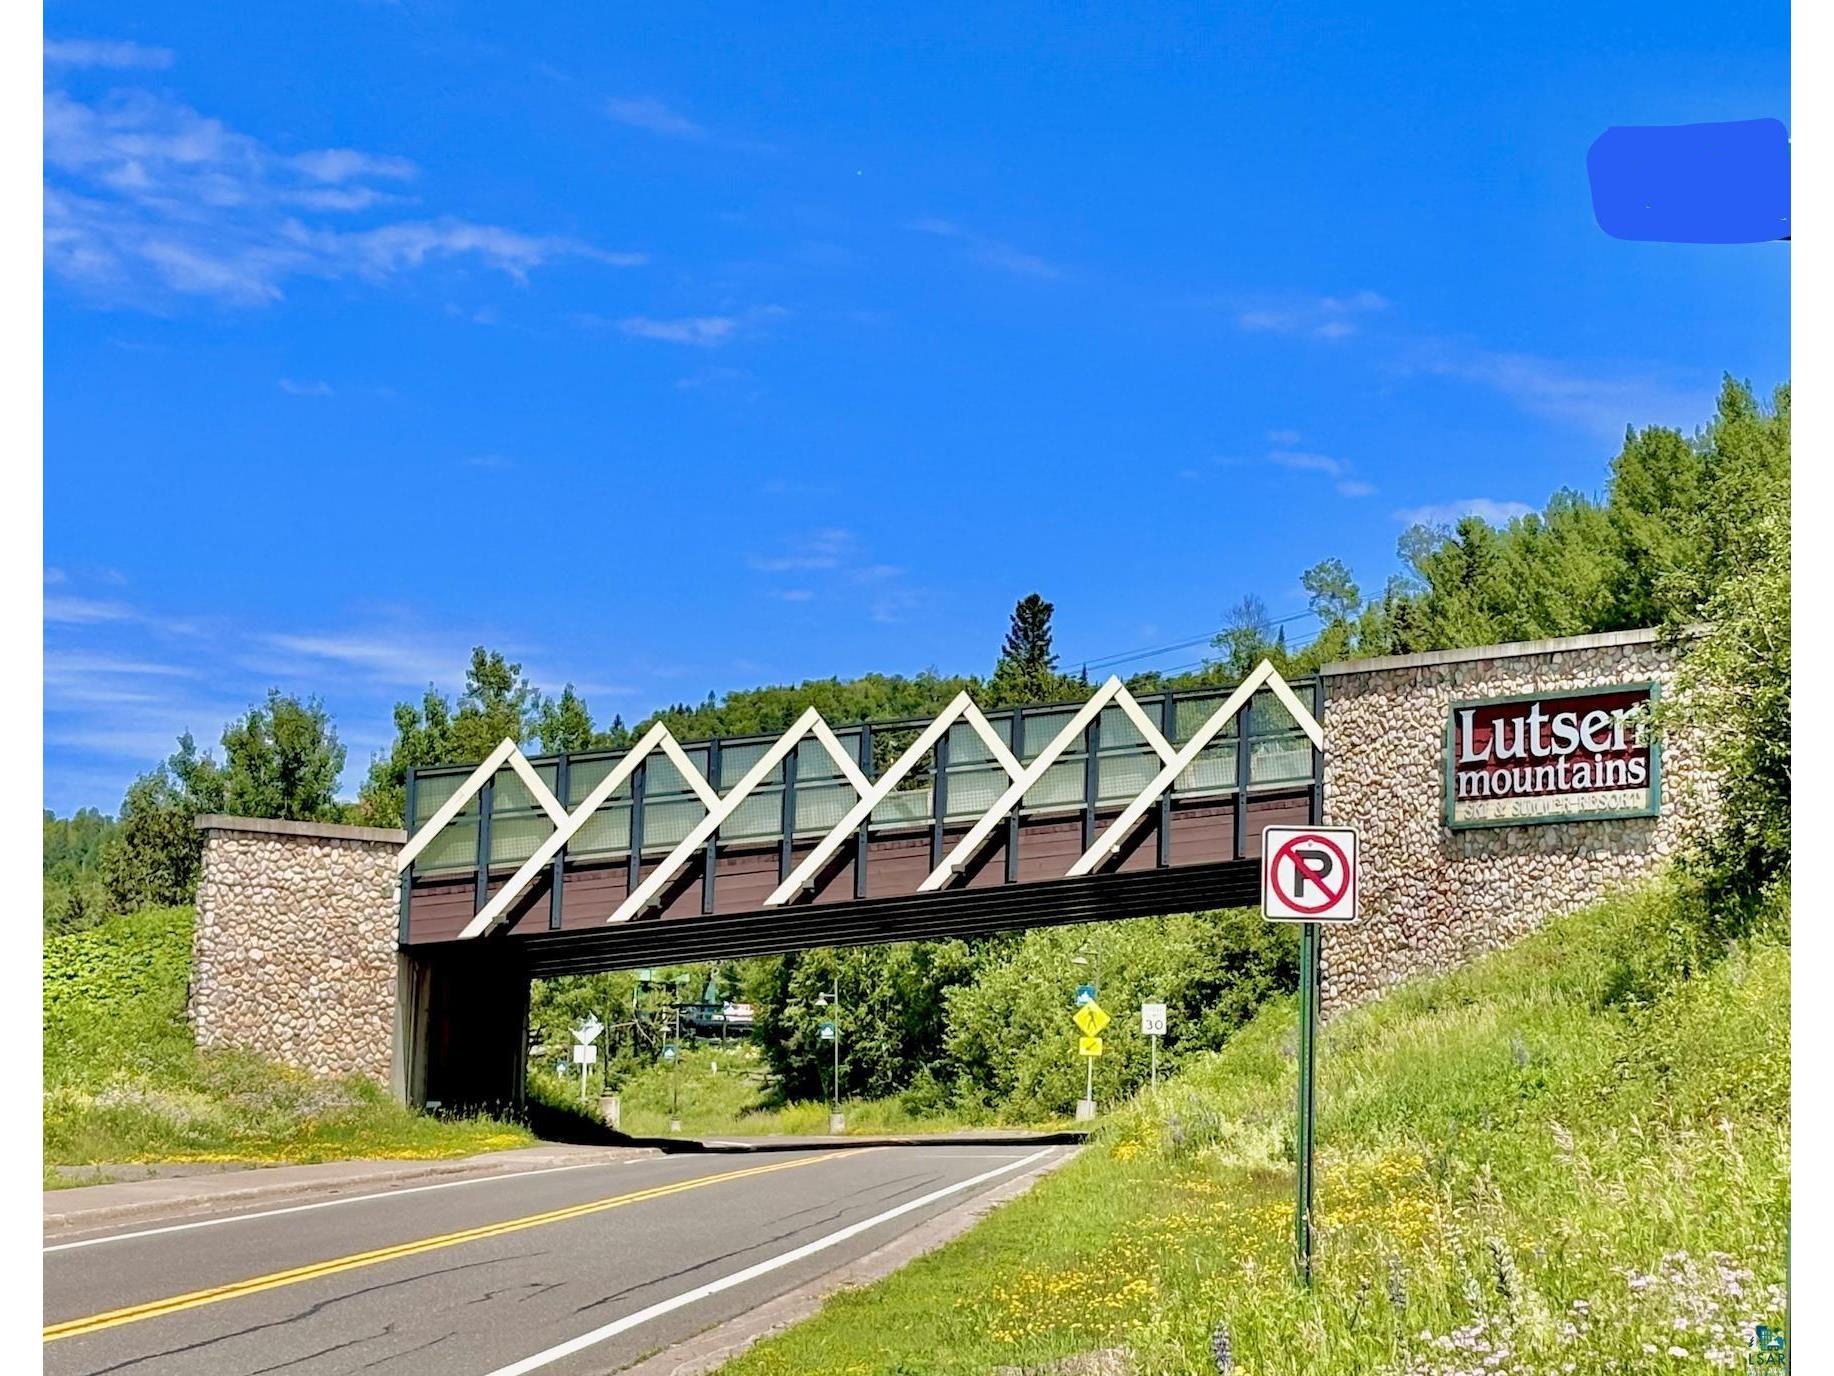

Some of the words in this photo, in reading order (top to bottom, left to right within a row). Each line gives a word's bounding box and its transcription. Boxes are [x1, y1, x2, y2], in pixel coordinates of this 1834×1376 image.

[1459, 702, 1649, 764] Lutsen
[1458, 754, 1646, 798] mountains
[1294, 850, 1333, 898] P
[1145, 1019, 1163, 1030] 30
